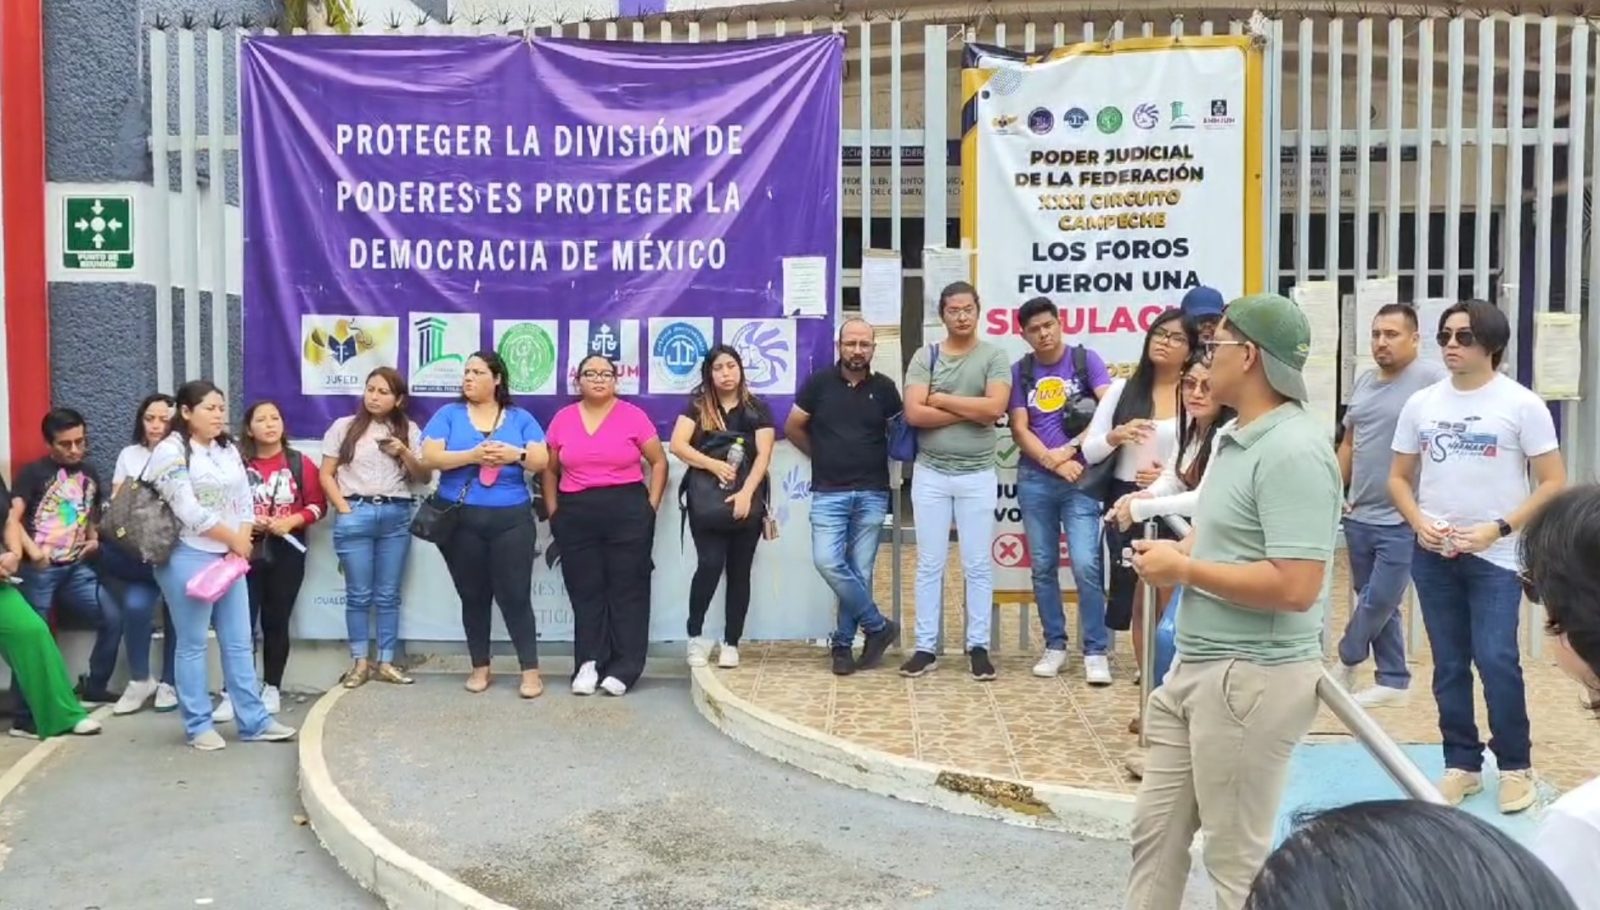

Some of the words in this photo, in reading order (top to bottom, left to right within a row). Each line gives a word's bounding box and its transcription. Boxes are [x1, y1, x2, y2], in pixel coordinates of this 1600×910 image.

[336, 123, 492, 157] PROTEGER
[506, 124, 541, 157] LA
[554, 117, 690, 157] DIVISIÓN
[706, 124, 743, 156] DE
[1030, 149, 1099, 165] PODER
[1105, 144, 1194, 164] JUDICIAL
[1015, 172, 1041, 187] DE
[1049, 171, 1074, 186] LA
[1079, 163, 1204, 186] FEDERACIÓN
[337, 181, 474, 214] PODERES
[487, 182, 522, 214] ES
[535, 182, 693, 214] PROTEGER
[706, 181, 740, 214] LA
[1038, 194, 1086, 210] XXXI
[1091, 189, 1181, 209] CIRCUITO
[1058, 212, 1167, 231] CAMPECHE
[350, 238, 548, 272] DEMOCRACIA
[561, 239, 598, 271] DE
[612, 232, 726, 271] MÉXICO
[1032, 241, 1087, 262] LOS
[1096, 238, 1190, 261] FOROS
[1018, 272, 1133, 294] FUERON
[1142, 270, 1201, 291] UNA
